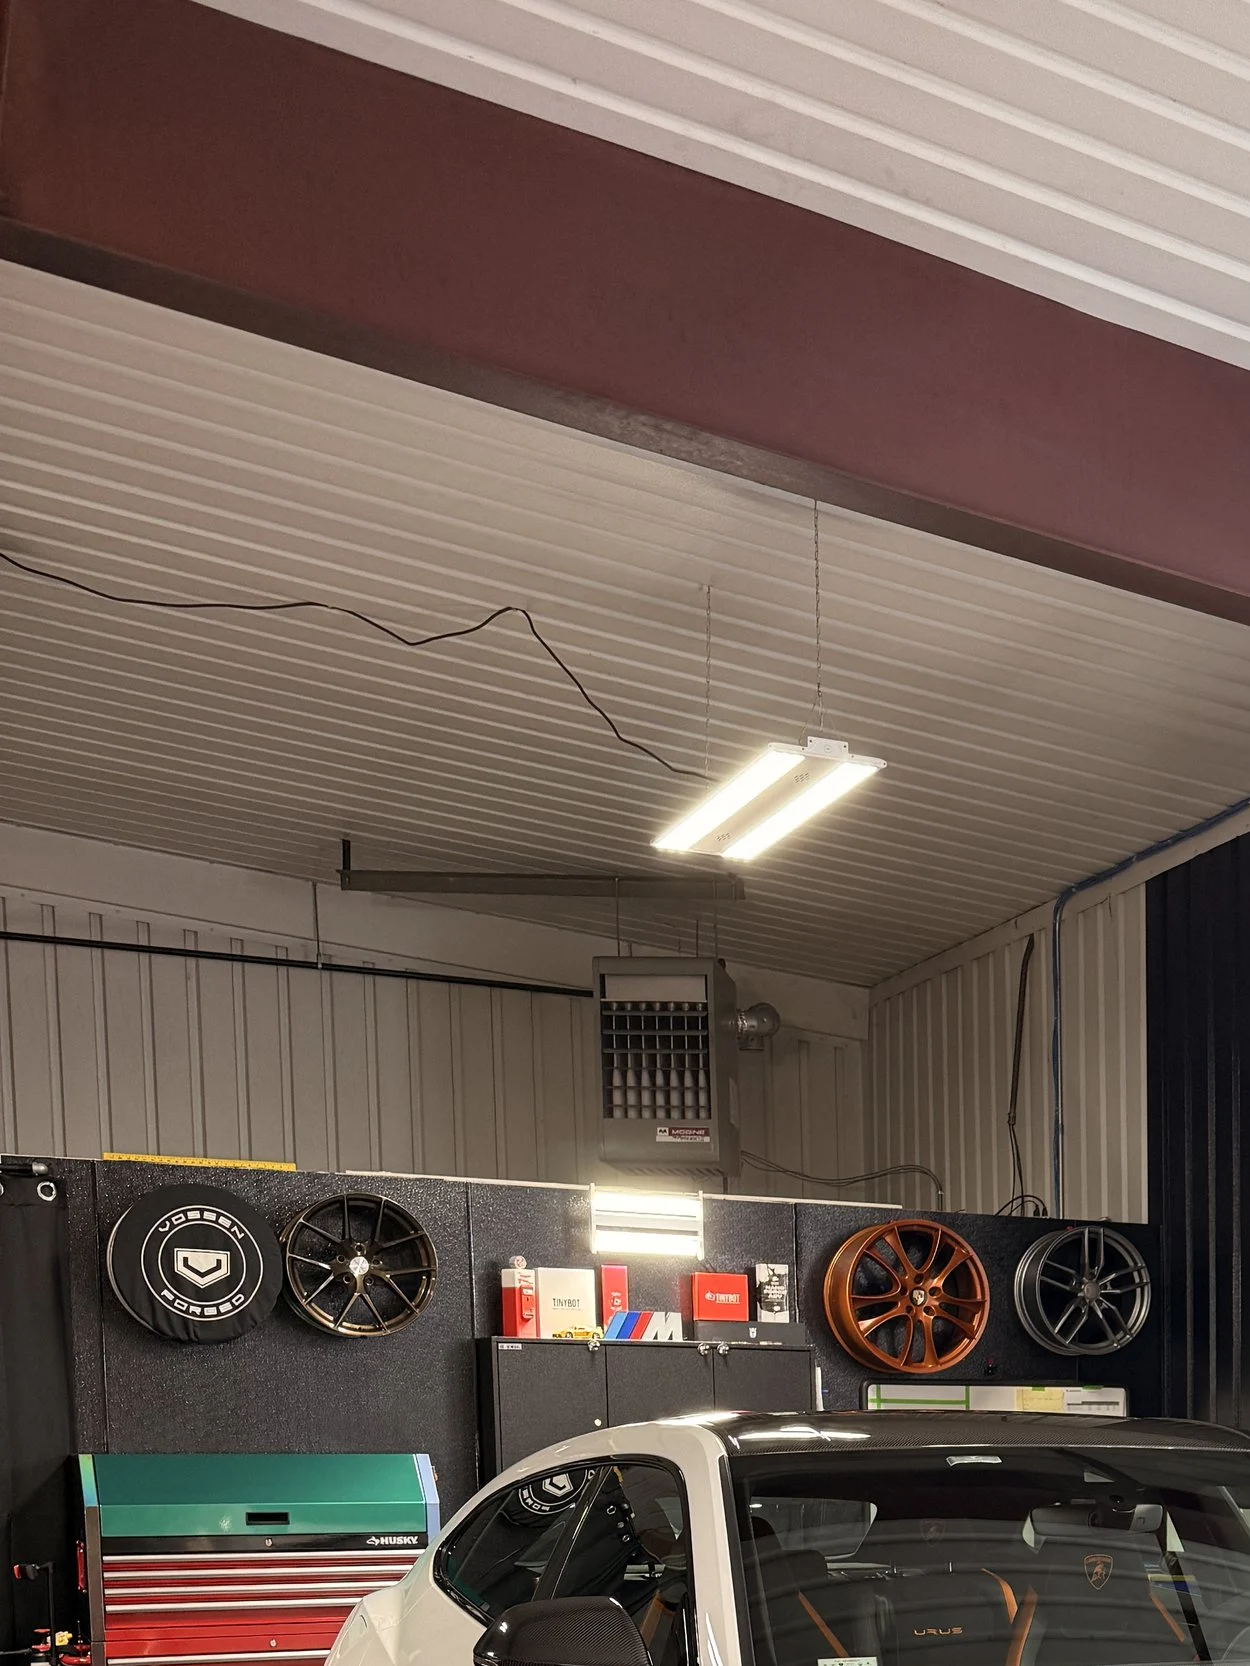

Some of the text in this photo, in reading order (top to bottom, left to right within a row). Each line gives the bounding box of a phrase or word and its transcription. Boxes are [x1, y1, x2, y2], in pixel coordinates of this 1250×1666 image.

[158, 1210, 245, 1240] VOSSEN
[160, 1288, 245, 1316] FORGED
[551, 1298, 581, 1308] TINYBOT
[715, 1293, 741, 1304] TINYBOT
[380, 1536, 418, 1545] HUSKY
[913, 1627, 963, 1636] URUS
